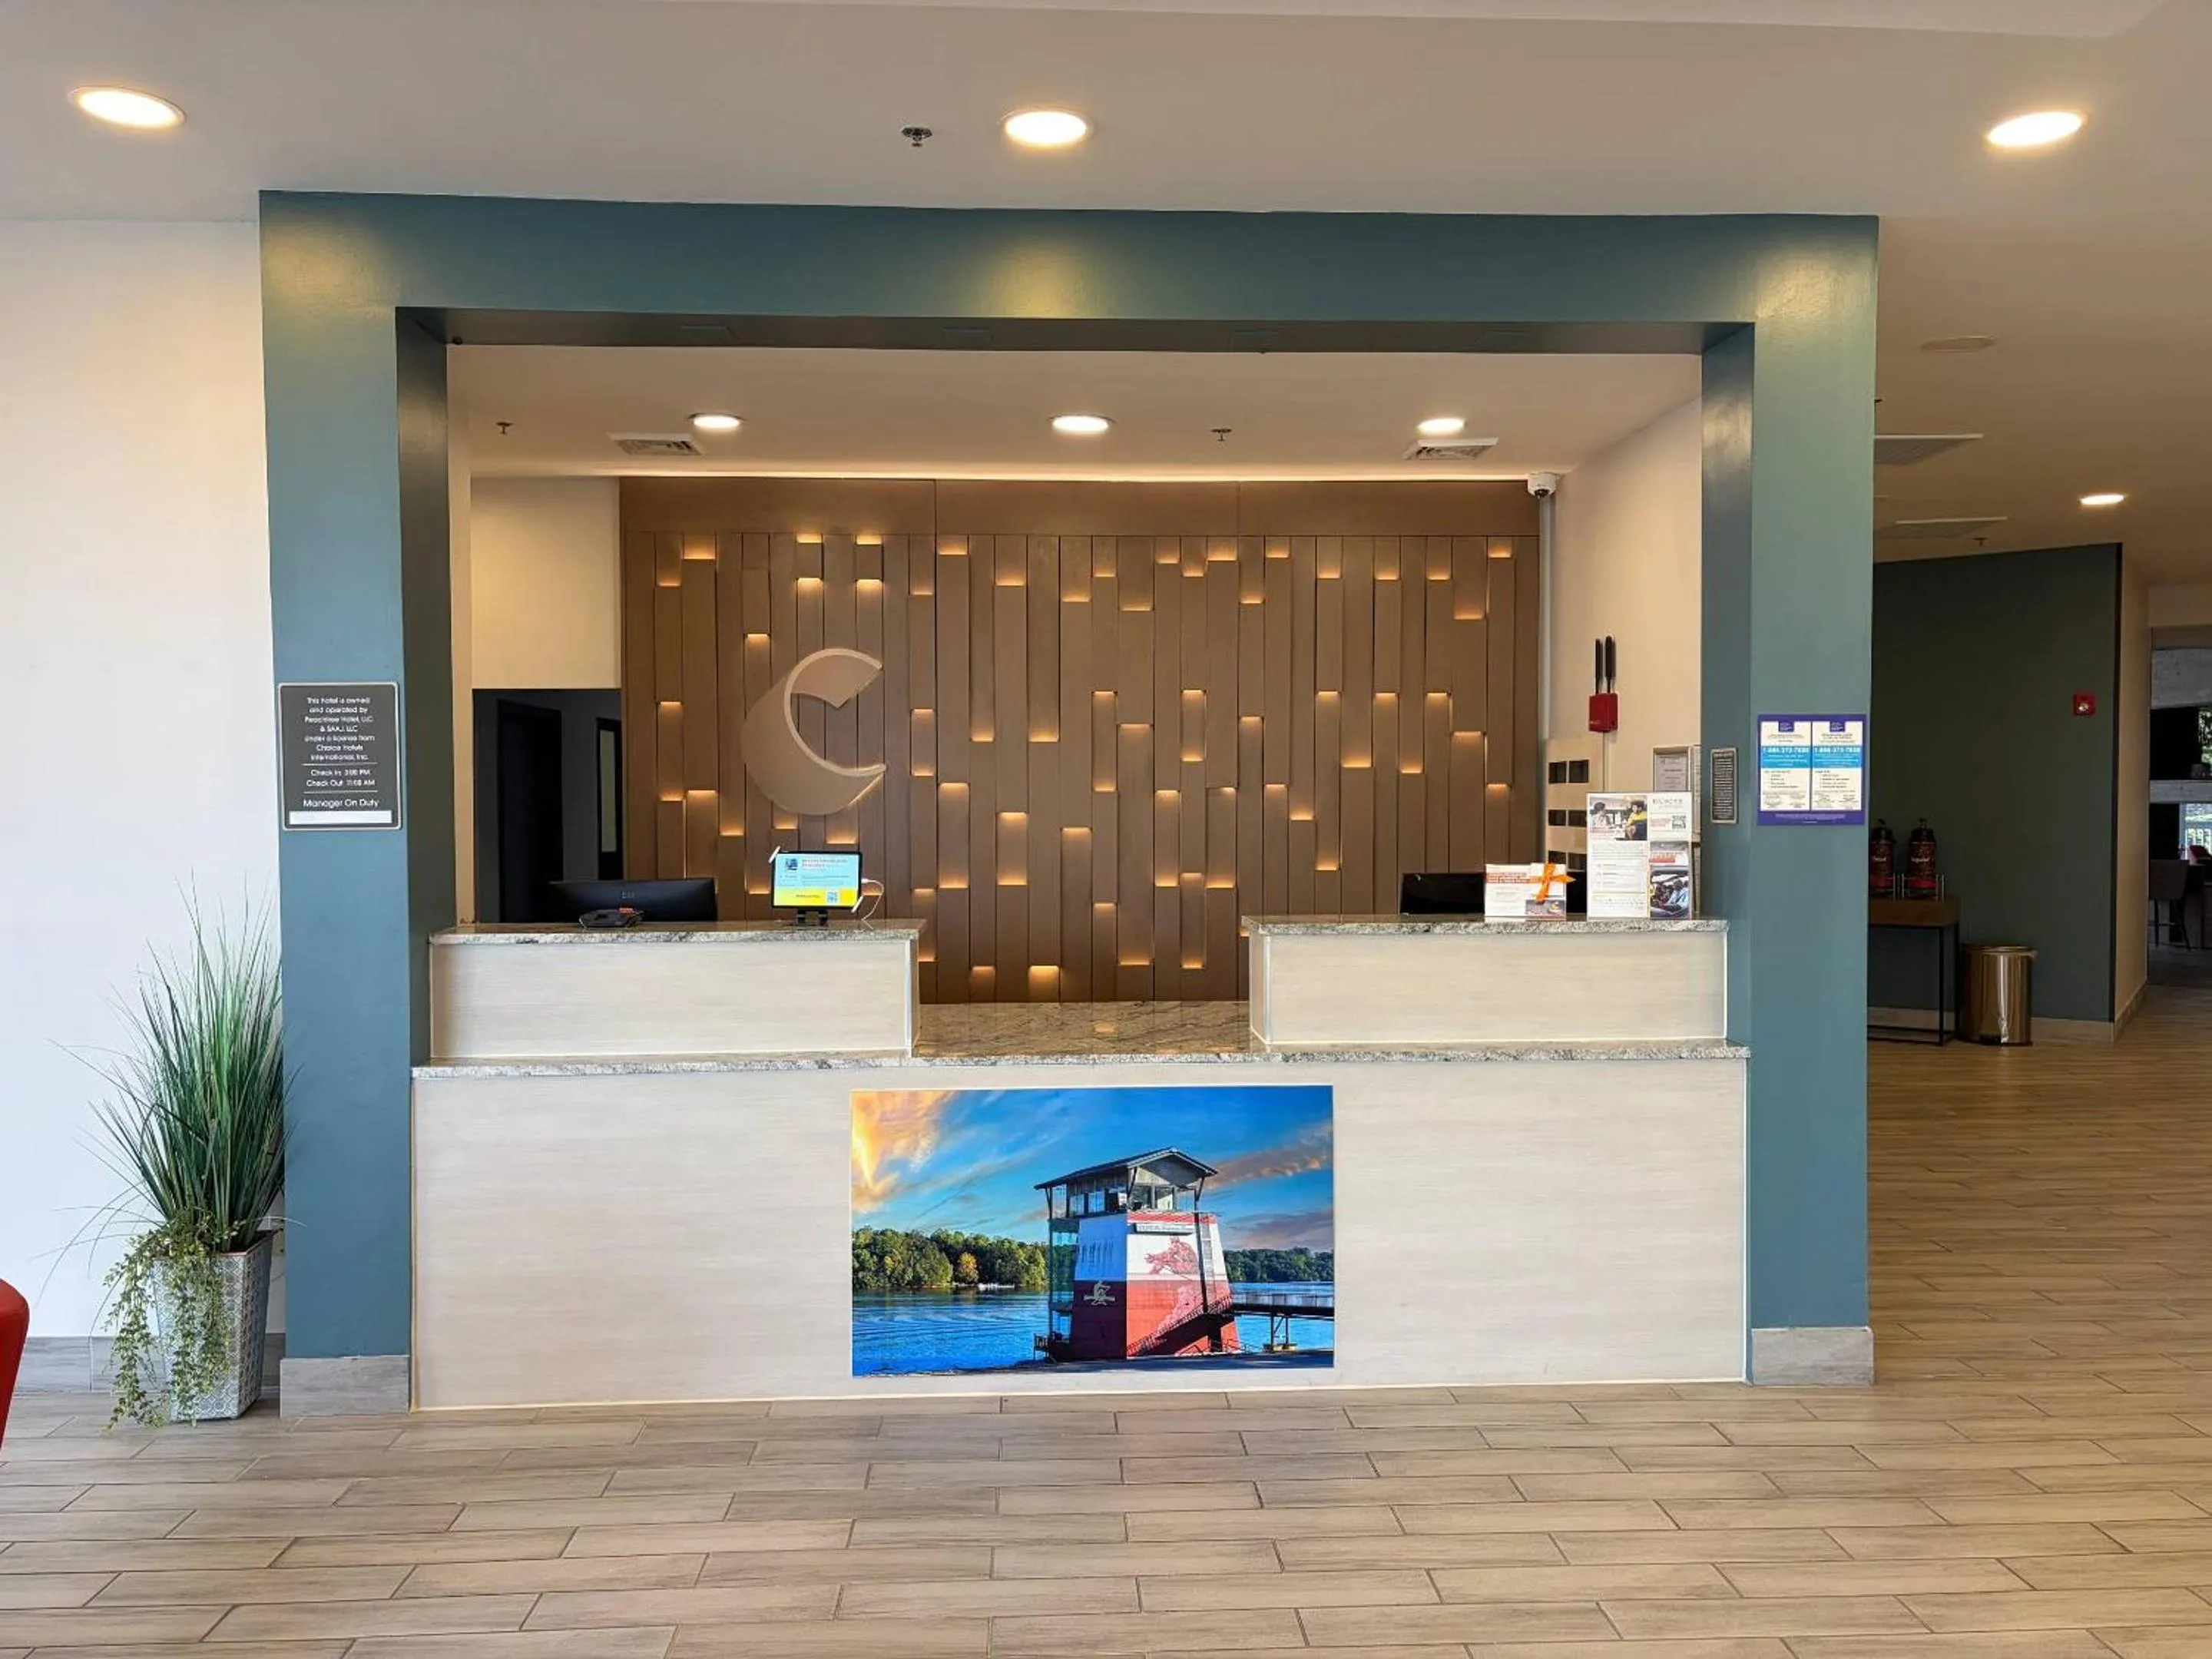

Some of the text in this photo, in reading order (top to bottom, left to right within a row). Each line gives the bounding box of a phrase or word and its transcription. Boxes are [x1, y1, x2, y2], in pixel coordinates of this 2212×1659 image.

[303, 798, 379, 809] Manager On Duty
